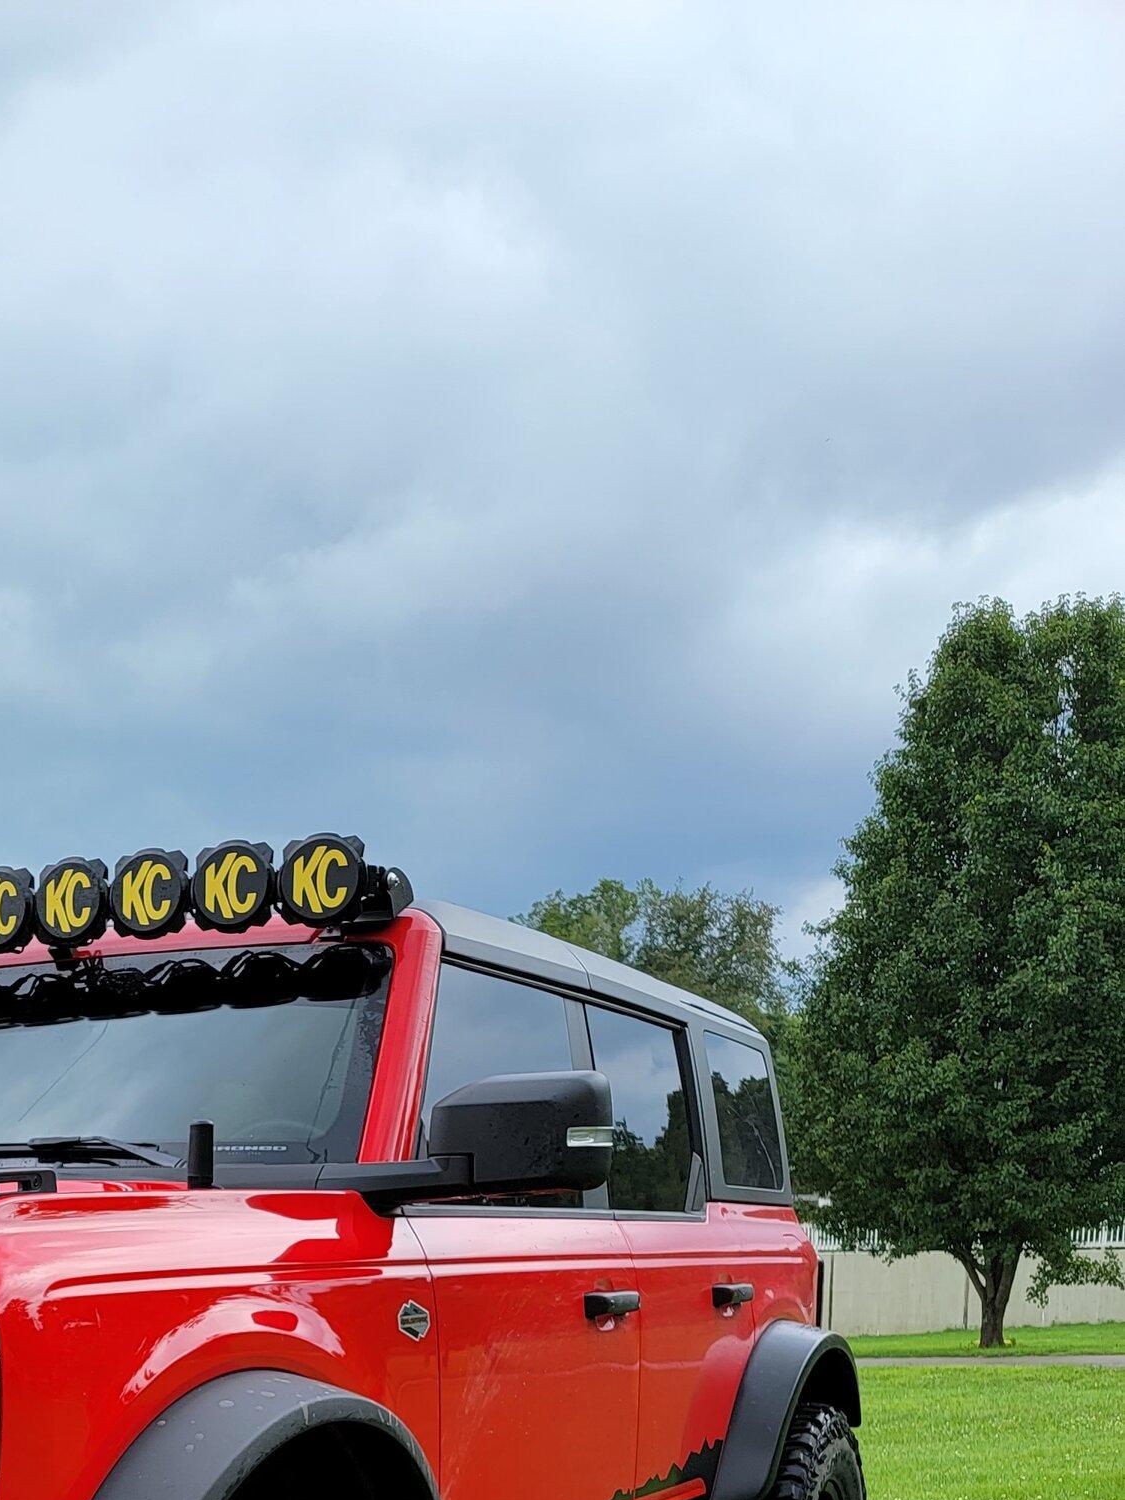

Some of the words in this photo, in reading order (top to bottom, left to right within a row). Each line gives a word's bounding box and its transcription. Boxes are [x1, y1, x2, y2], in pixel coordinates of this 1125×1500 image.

[46, 872, 92, 933] KC
[123, 862, 172, 925] KC
[205, 854, 258, 918] KC
[293, 847, 348, 913] KC
